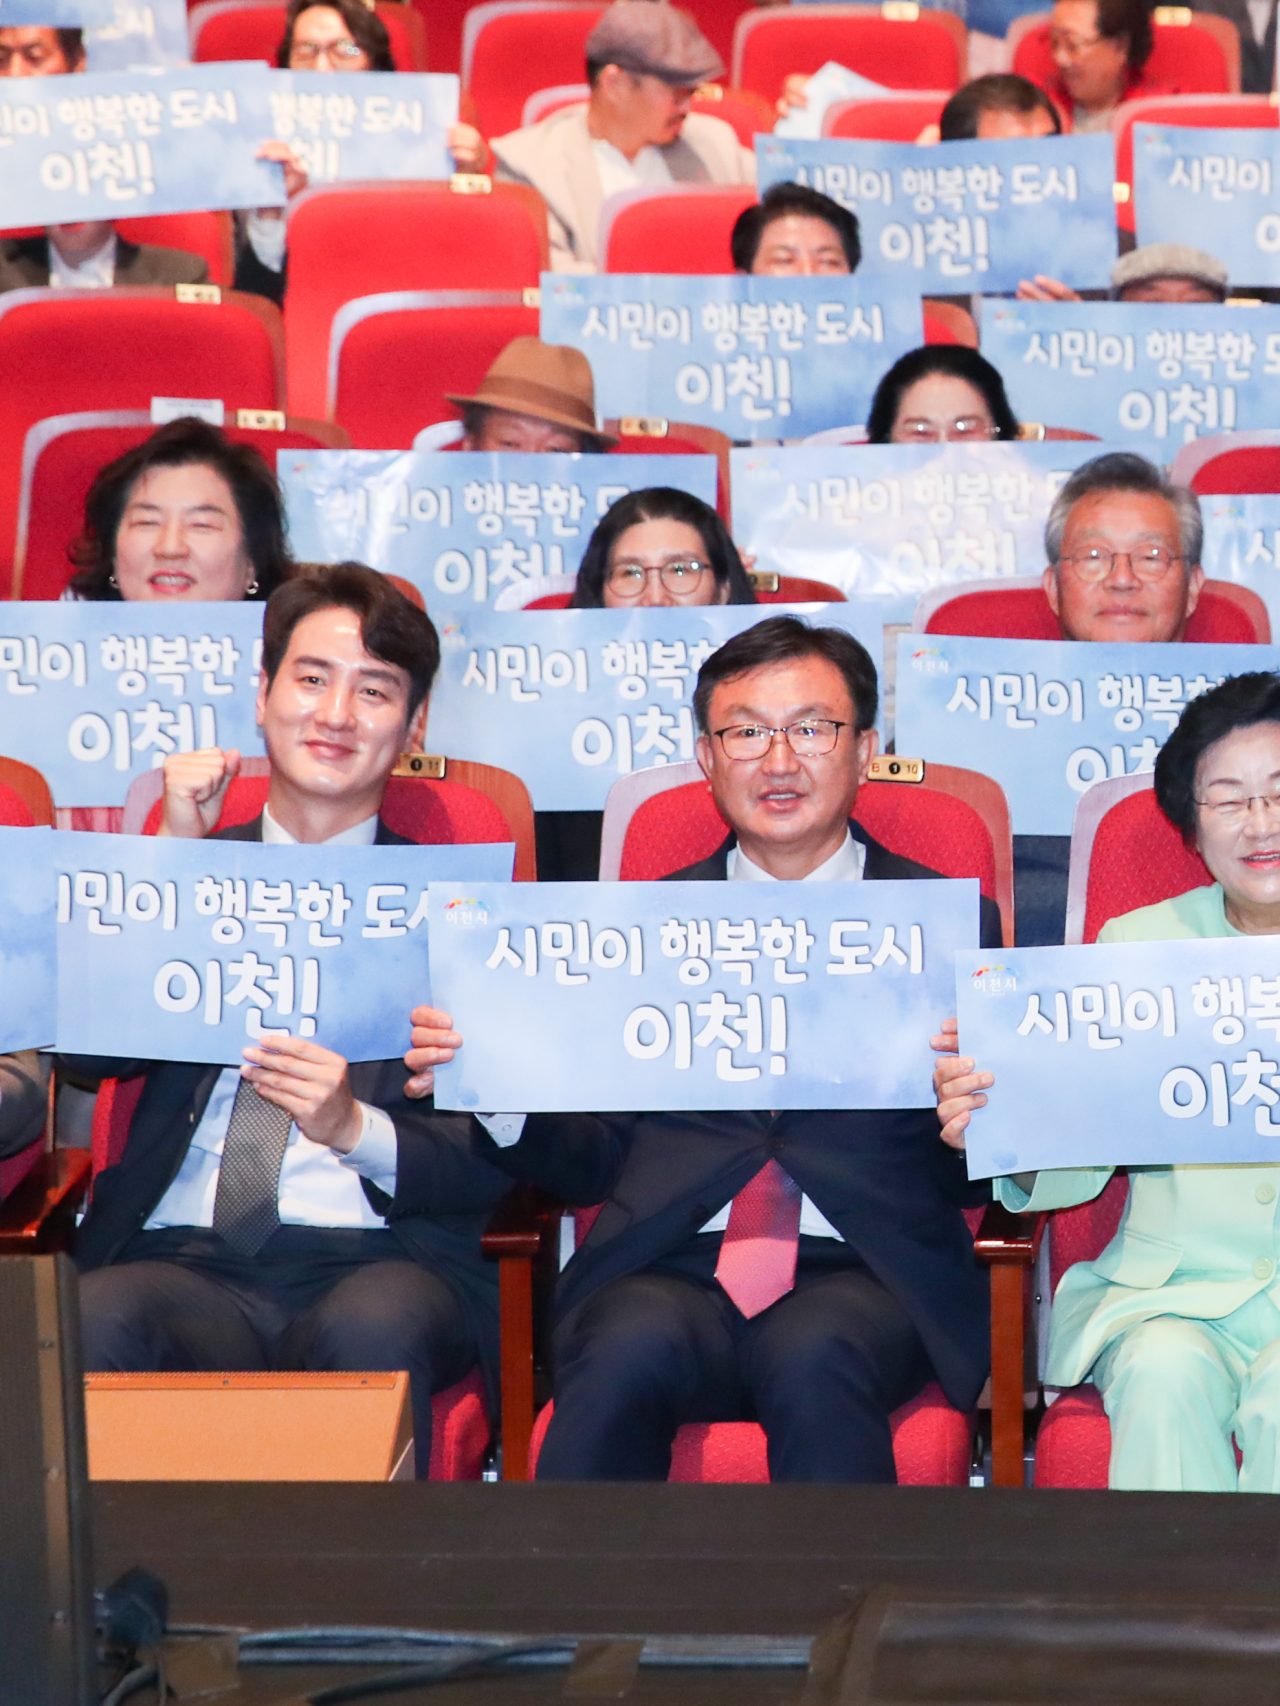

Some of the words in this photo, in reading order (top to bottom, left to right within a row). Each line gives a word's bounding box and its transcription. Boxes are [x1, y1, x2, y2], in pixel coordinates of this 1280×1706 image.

[58, 88, 163, 141] 행복한
[169, 88, 238, 128] 도시
[361, 96, 424, 135] 도시
[40, 138, 156, 200] 이천!
[902, 164, 1004, 214] 행복한
[1010, 164, 1078, 205] 도시
[1168, 155, 1271, 200] 시민이
[879, 216, 990, 277] 이천!
[580, 301, 693, 350] 시민이
[701, 301, 808, 352] 행복한
[815, 303, 885, 345] 도시
[1023, 329, 1135, 376] 시민이
[1146, 330, 1257, 381] 행복한
[674, 353, 793, 422] 이천!
[463, 479, 586, 537] 행복한
[785, 476, 902, 527] 시민이
[913, 470, 1034, 527] 행복한
[0, 633, 88, 697] 민이
[101, 633, 241, 698] 행복한
[462, 644, 590, 703] 시민이
[946, 673, 1084, 730] 시민이
[68, 700, 219, 773] 이천!
[570, 705, 698, 776] 이천
[906, 764, 919, 774] 10
[195, 875, 352, 948] 행복한
[445, 912, 489, 926] 이천시
[486, 926, 645, 986] 시민이
[660, 917, 815, 986] 행복한
[826, 920, 925, 975] 도시
[153, 951, 321, 1041] 이천!
[973, 977, 1017, 992] 이천시
[622, 991, 788, 1083] 이천!
[1017, 985, 1177, 1050] 시민이
